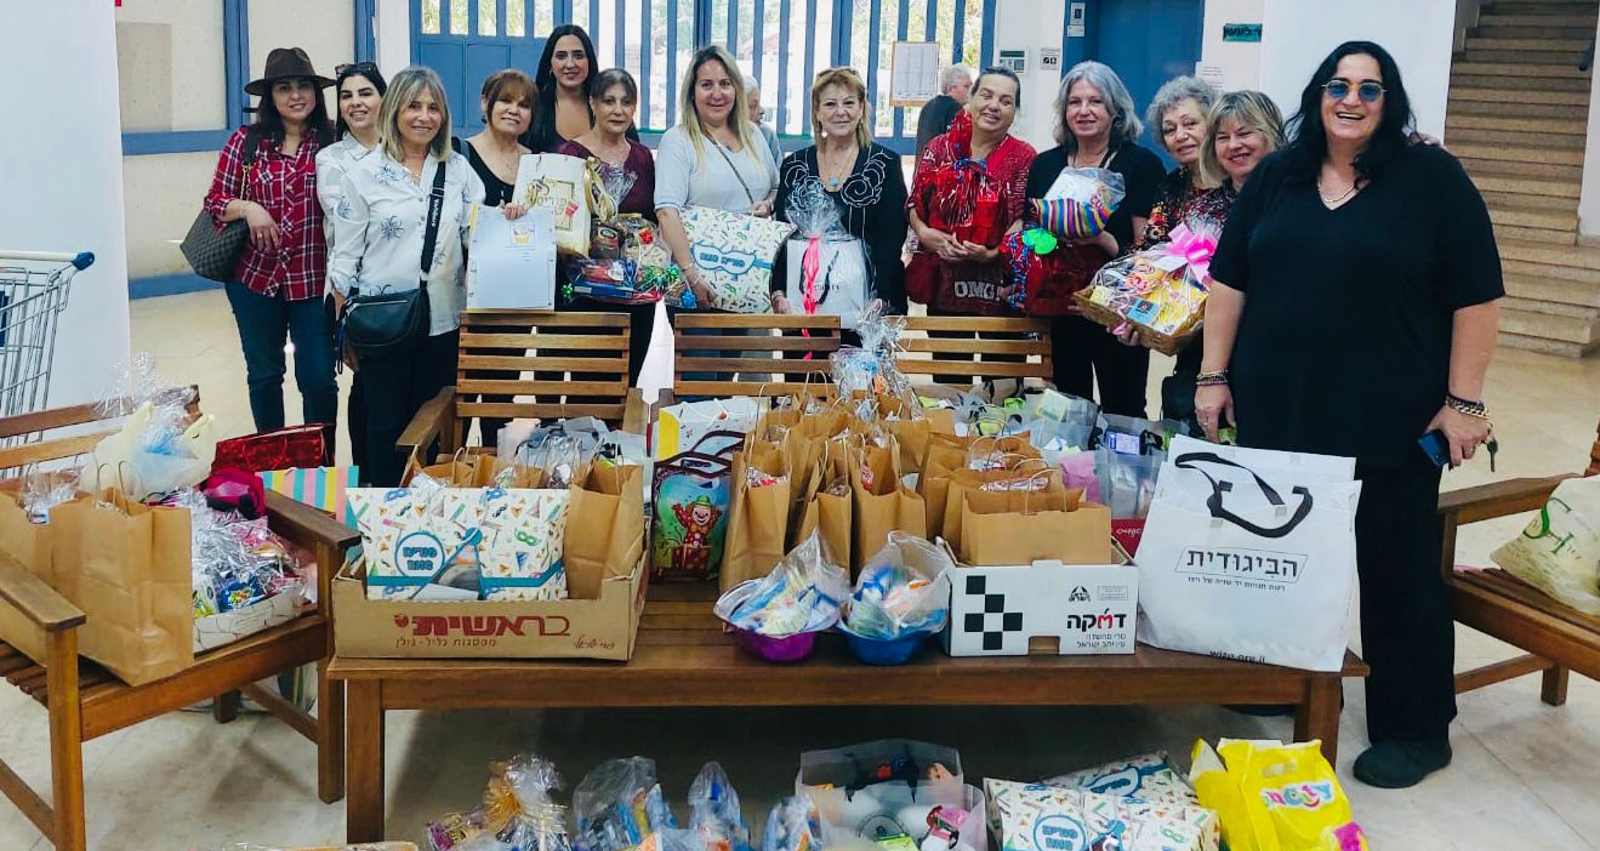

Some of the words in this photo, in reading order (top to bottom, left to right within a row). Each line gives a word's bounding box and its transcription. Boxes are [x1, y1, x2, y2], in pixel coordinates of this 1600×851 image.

[1187, 550, 1298, 577] הביגודית
[412, 615, 571, 636] בראשית
[1067, 608, 1127, 632] דמקה
